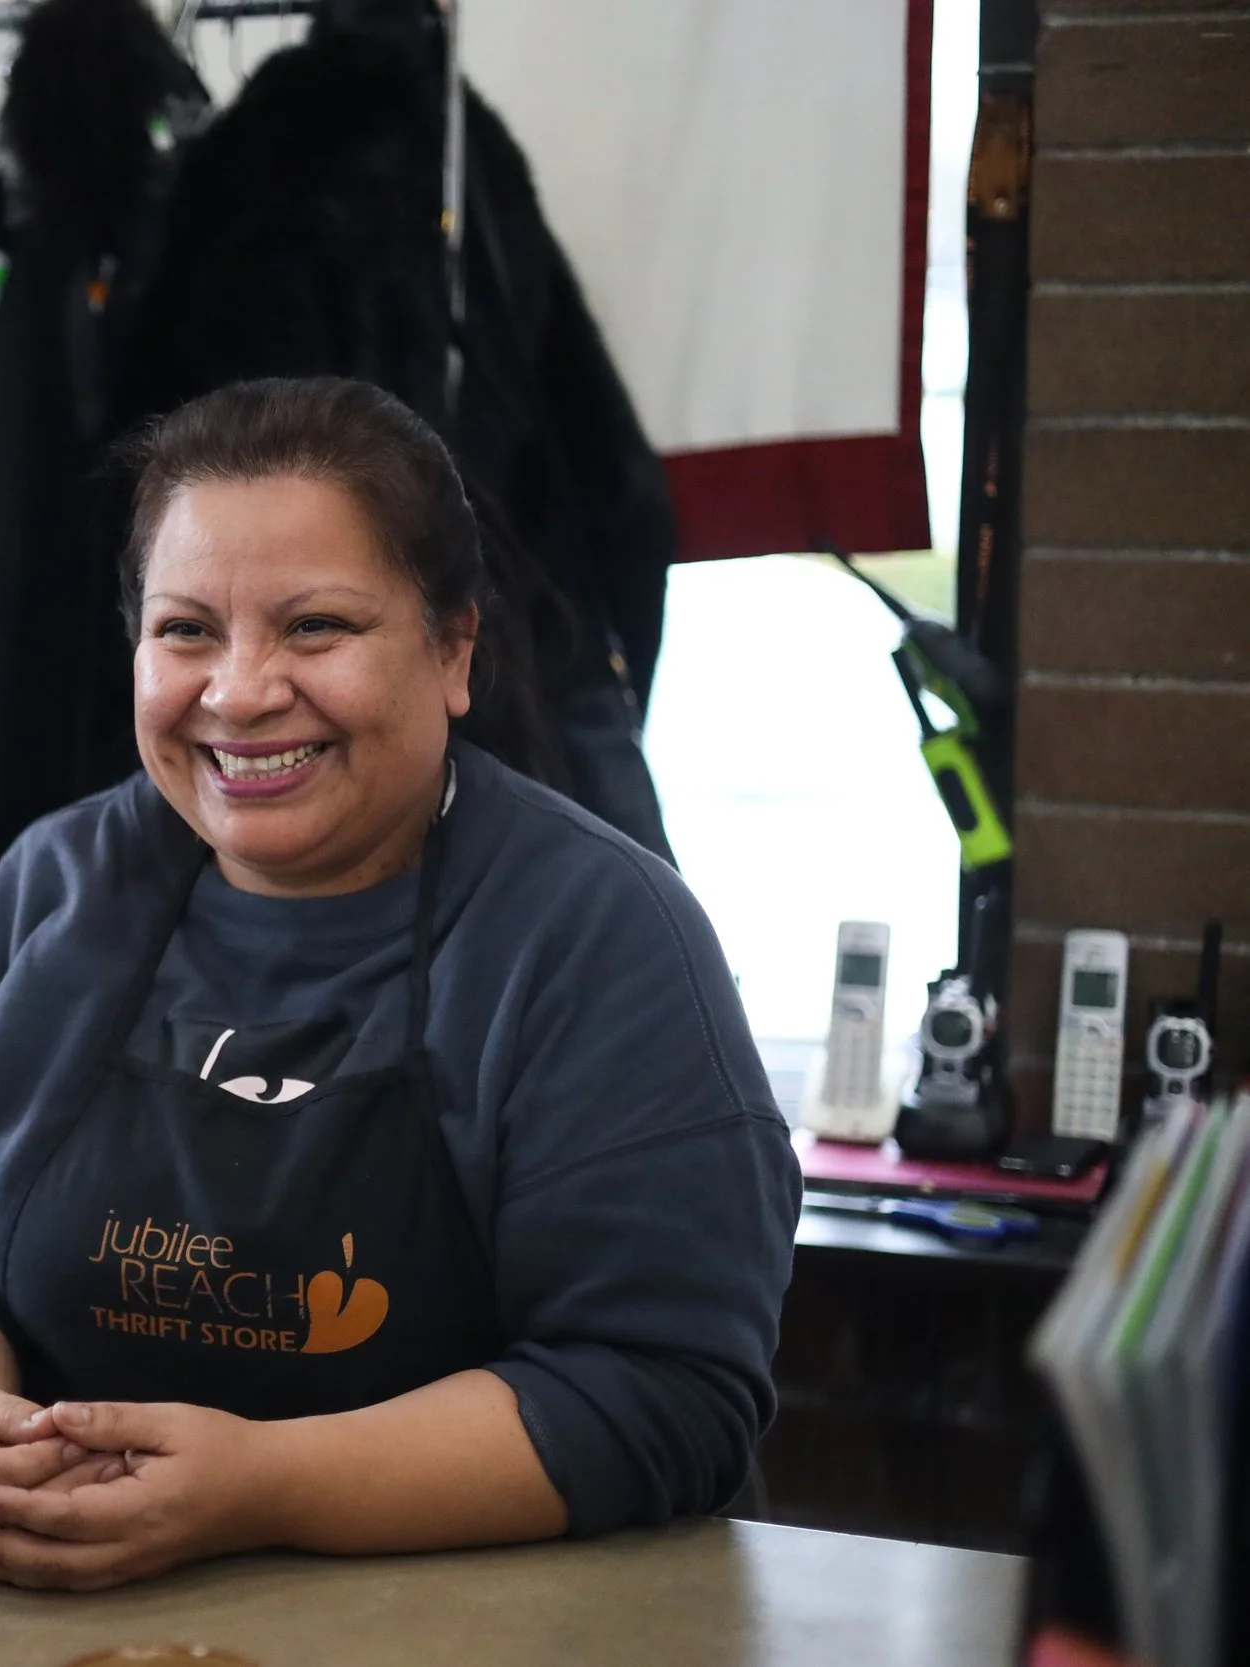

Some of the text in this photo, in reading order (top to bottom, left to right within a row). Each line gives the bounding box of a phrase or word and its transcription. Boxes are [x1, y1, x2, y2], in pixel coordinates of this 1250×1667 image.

[89, 1209, 233, 1269] jubilee
[121, 1258, 305, 1319] REACH
[90, 1305, 297, 1352] THRIFT STORE
